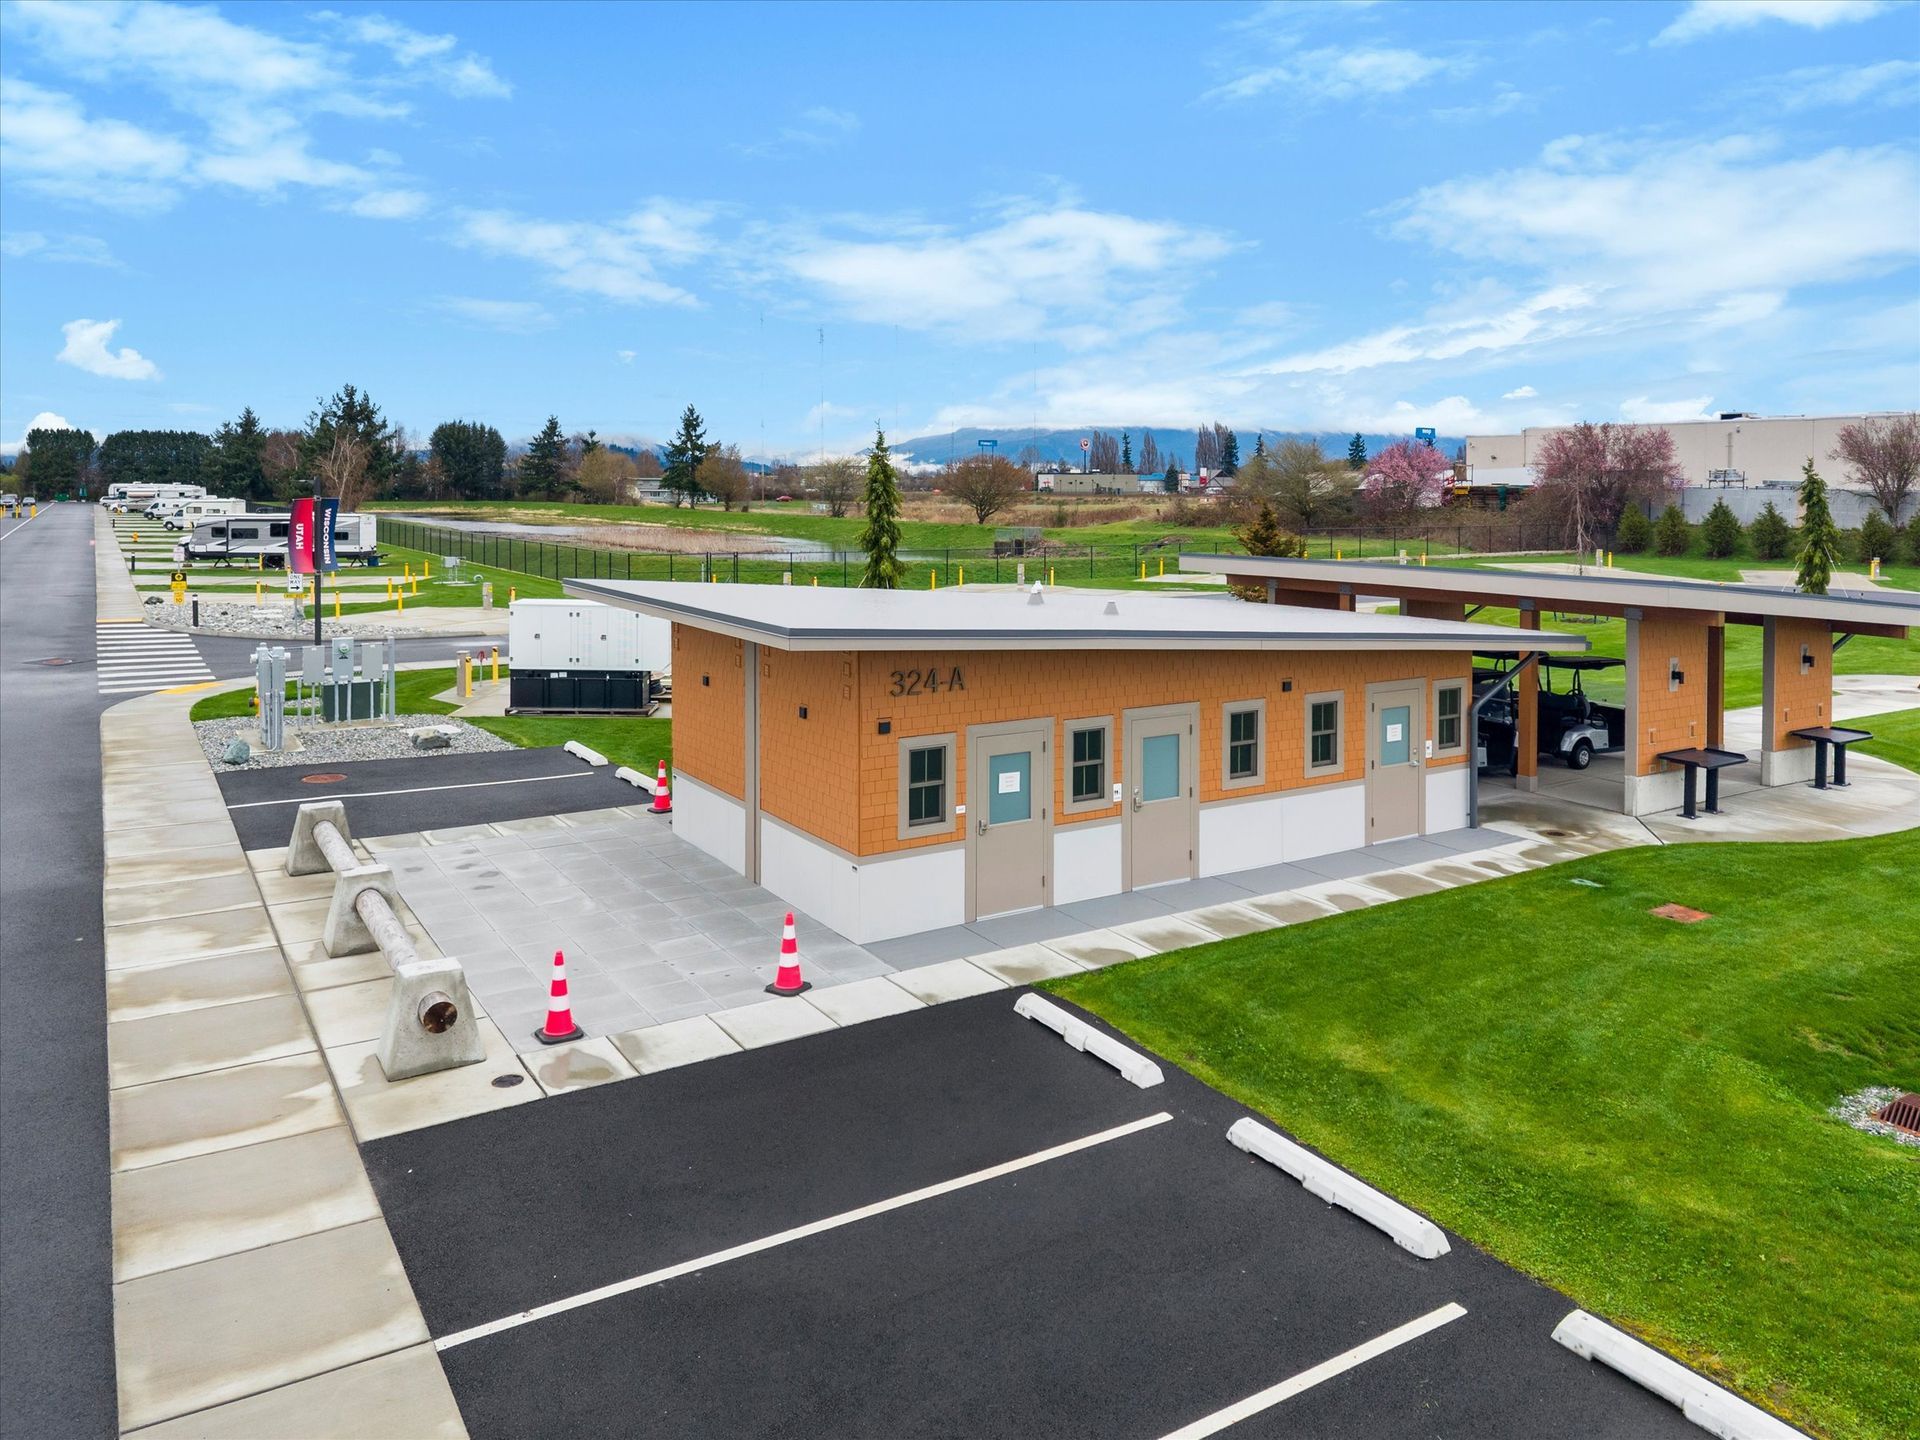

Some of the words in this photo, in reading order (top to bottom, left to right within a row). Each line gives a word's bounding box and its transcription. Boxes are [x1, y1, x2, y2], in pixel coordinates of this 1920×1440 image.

[295, 523, 304, 550] UTAH
[323, 508, 333, 565] WISCONSIN
[889, 666, 966, 697] 324-A
